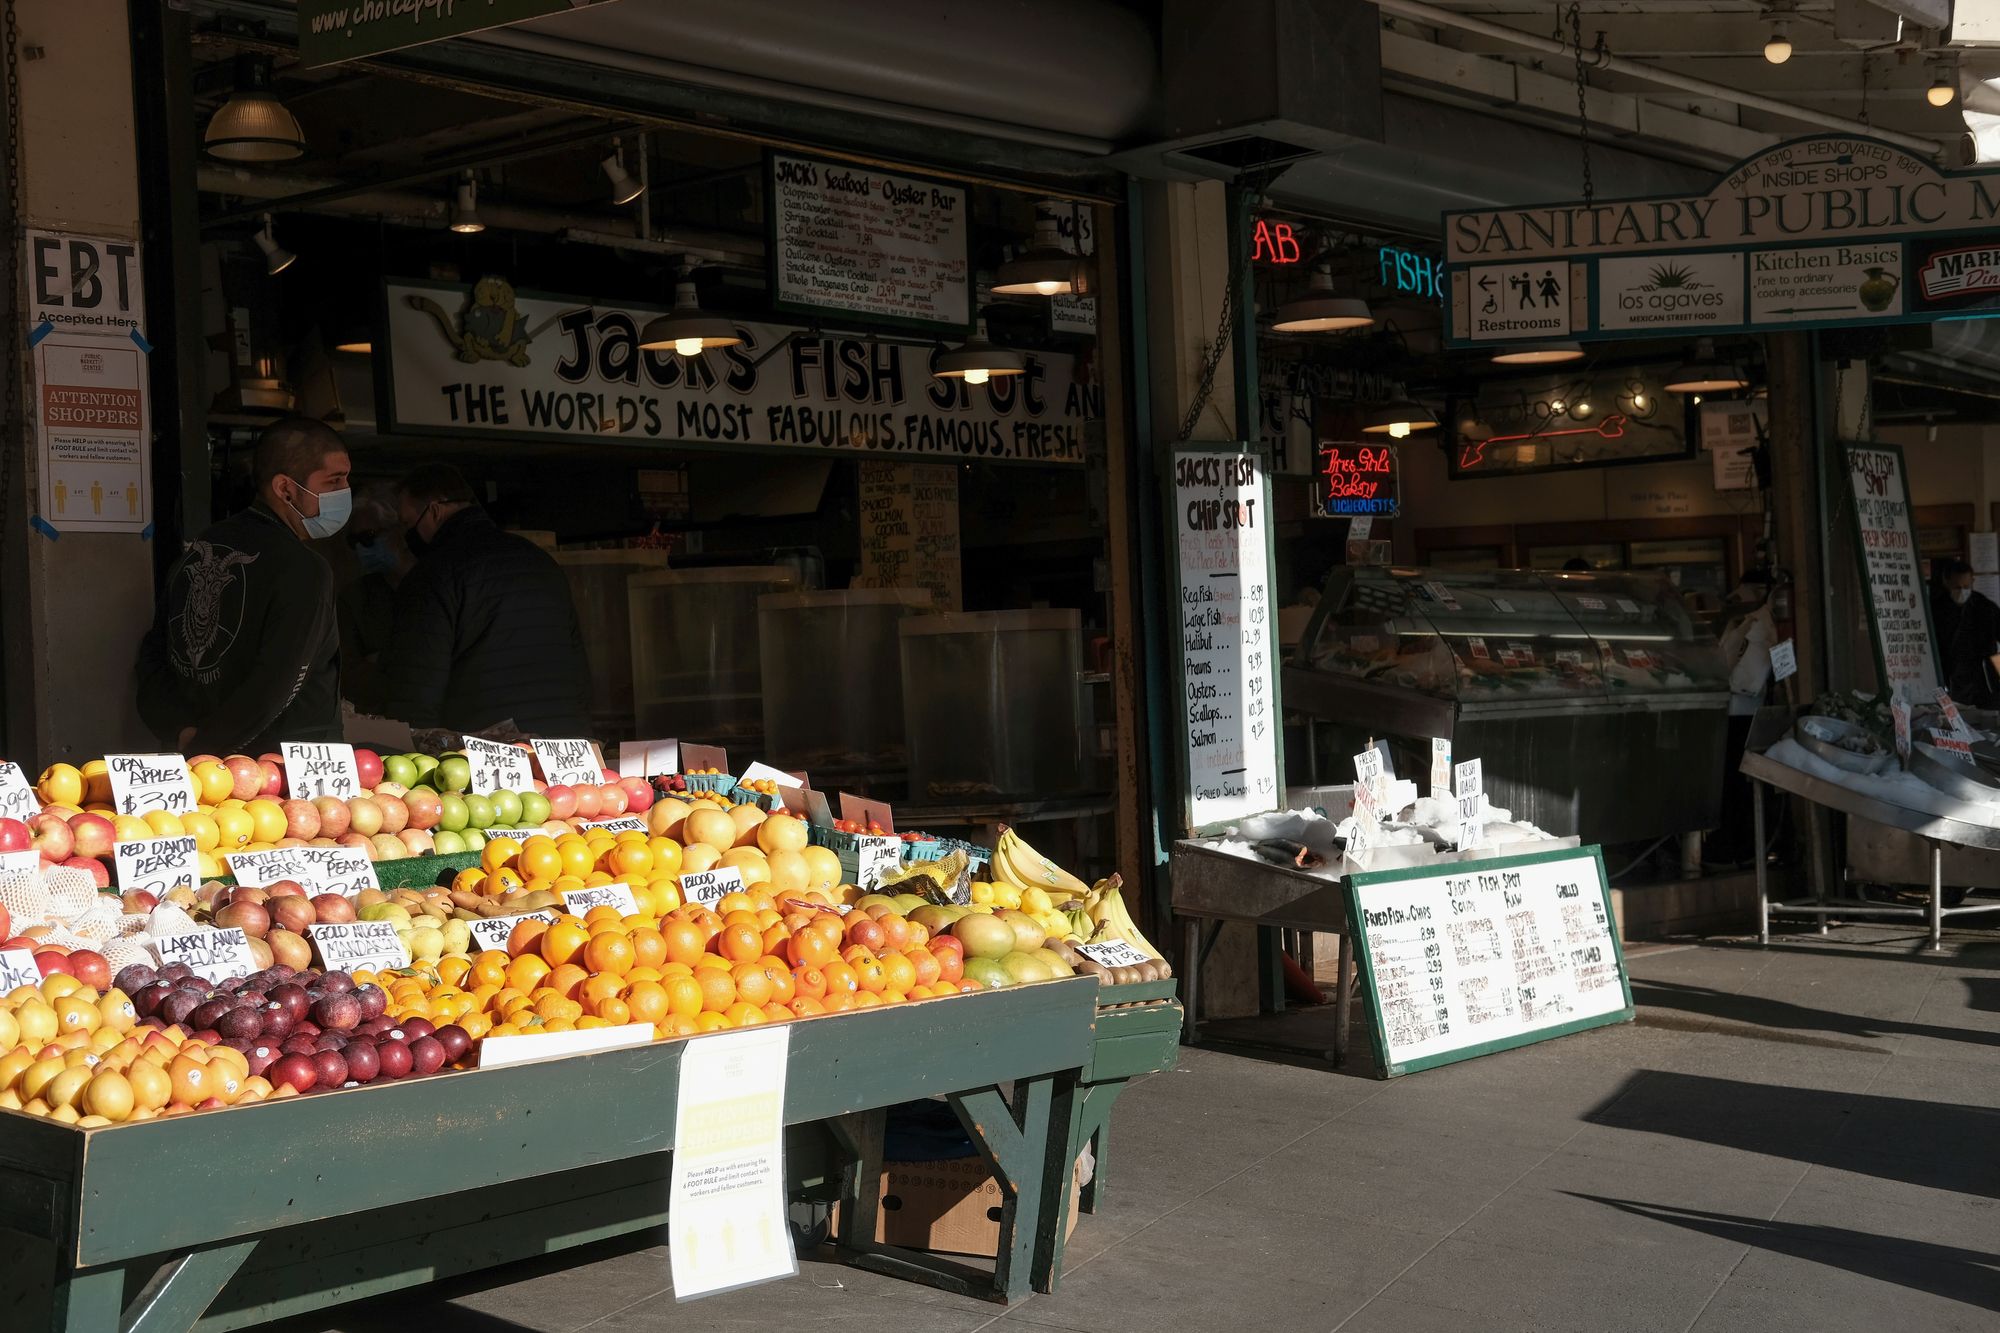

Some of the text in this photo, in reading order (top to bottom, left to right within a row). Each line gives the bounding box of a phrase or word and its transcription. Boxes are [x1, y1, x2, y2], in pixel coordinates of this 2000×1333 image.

[1728, 142, 1925, 190] BUILT 1910 RENOVATED 1981
[1762, 164, 1888, 188] INSIDE SHOPS
[776, 162, 956, 211] JACK'S Seafood Oyster Bar
[1455, 198, 1719, 254] SANITARY
[1736, 181, 1947, 237] PUBLIC
[1754, 246, 1898, 271] Kitchen Basics
[34, 237, 134, 311] EBT
[1379, 245, 1433, 297] FISH
[1757, 272, 1834, 286] fine to ordinary
[1757, 284, 1857, 299] cooking accessories
[1619, 292, 1724, 312] los agaves
[38, 312, 138, 328] Accepted Here
[1478, 318, 1561, 332] Restrooms
[791, 336, 906, 409] FISH
[49, 391, 136, 408] ATTENTION
[49, 407, 138, 425] SHOPPERS
[442, 384, 509, 425] THE
[520, 388, 662, 436] WORLD'S
[677, 401, 753, 442] MOST
[1176, 458, 1220, 489] JACK'S
[1185, 634, 1213, 652] Halibut
[1186, 658, 1212, 676] Prawns
[1187, 682, 1216, 707] Oysters
[1190, 729, 1217, 748] Salmon
[289, 746, 332, 766] FUJI
[534, 740, 593, 757] PINK LADY
[112, 757, 151, 772] OPAL
[484, 754, 517, 768] APPLE
[556, 754, 586, 770] APPLE
[129, 768, 184, 786] APPLES
[304, 760, 348, 782] APPLE
[1458, 795, 1480, 820] TROUT
[120, 841, 146, 858] RED
[861, 837, 887, 849] LEMON
[232, 848, 296, 870] BARTLETT
[874, 847, 897, 862] LIME
[134, 852, 187, 878] PEARS
[258, 859, 369, 880] PEARS PEARS
[684, 872, 717, 889] BLOOD
[1478, 874, 1500, 894] FISH
[1502, 872, 1522, 890] SPOT
[1386, 906, 1406, 926] FISH
[1410, 904, 1432, 922] CHIPS
[315, 924, 349, 941] GOLD
[474, 920, 512, 934] CARA
[160, 929, 247, 954] LARRY ANNE
[1082, 944, 1107, 954] KIWI
[1100, 942, 1131, 956] FRUIT
[179, 946, 238, 966] PLUMS
[688, 1176, 718, 1188] FOOT RULE
